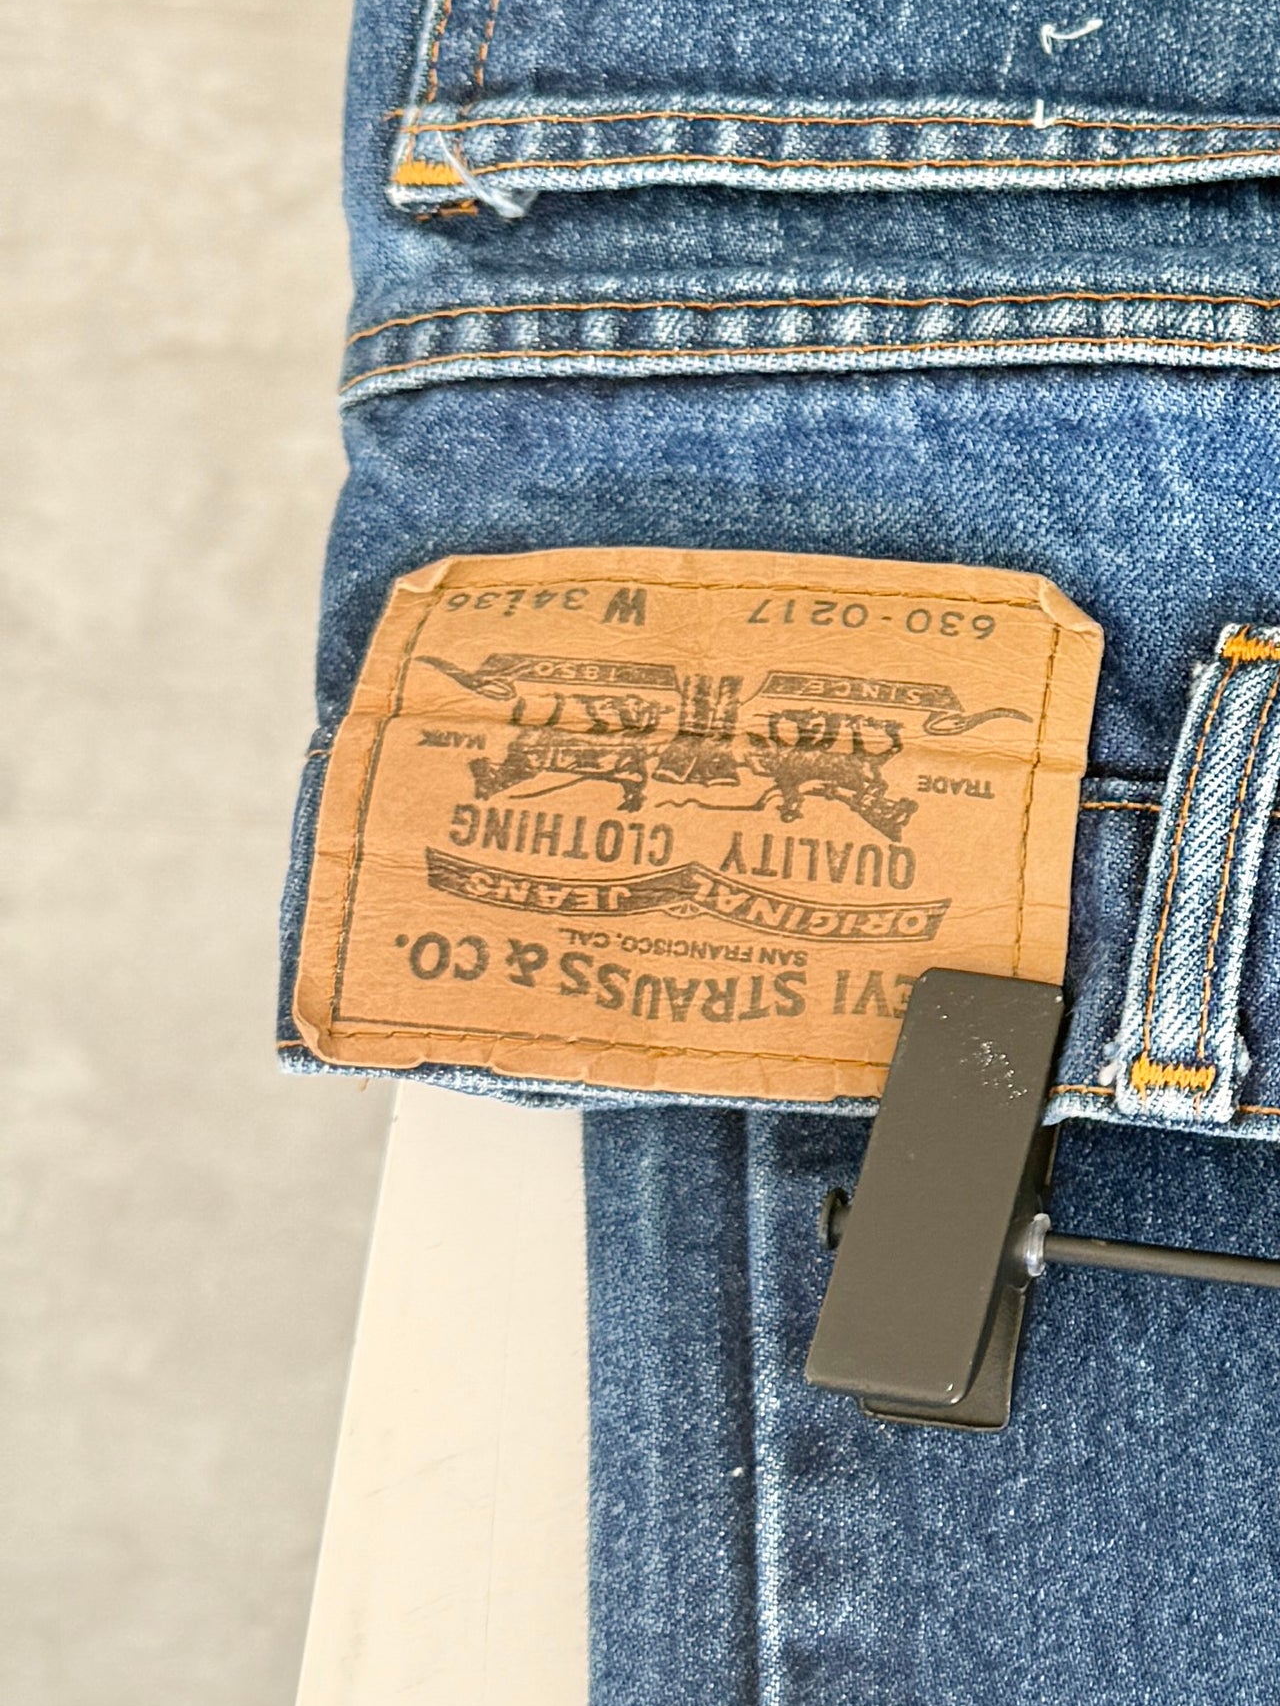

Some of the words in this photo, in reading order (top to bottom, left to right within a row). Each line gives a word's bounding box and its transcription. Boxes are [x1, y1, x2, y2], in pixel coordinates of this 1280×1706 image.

[602, 587, 648, 626] W
[535, 660, 617, 683] 1850
[801, 679, 922, 705] SINCE
[417, 729, 486, 750] MARK
[918, 774, 995, 799] TRADE
[449, 804, 674, 866] CLOTHING
[720, 831, 916, 890] QUALITY
[464, 872, 631, 910] JEANS
[692, 873, 929, 935] ORIGINAL
[395, 931, 490, 981] CO.
[505, 938, 549, 987] &
[759, 946, 808, 968] SAN
[558, 951, 808, 1023] STRAUSS
[832, 970, 916, 1020] EVI
